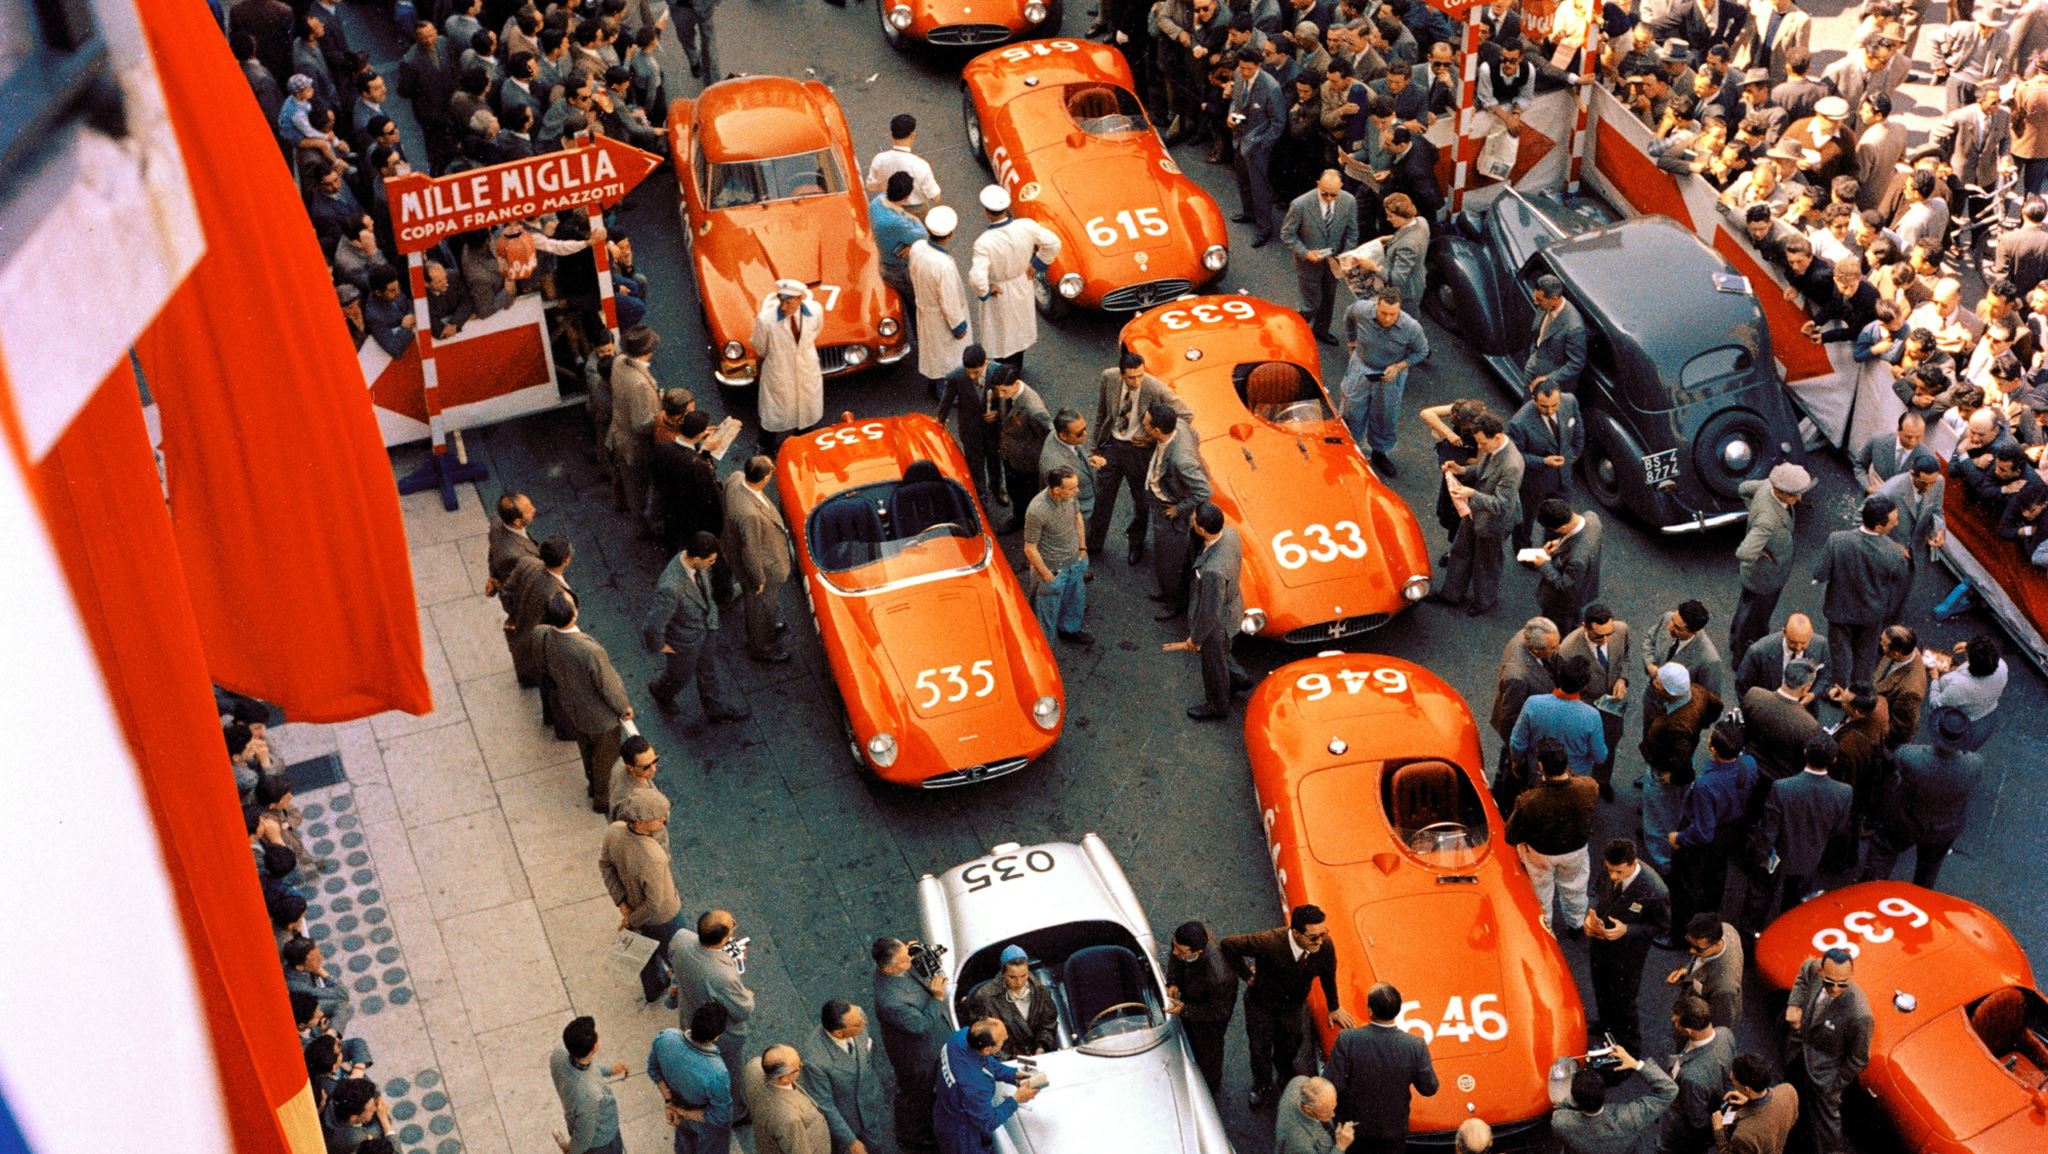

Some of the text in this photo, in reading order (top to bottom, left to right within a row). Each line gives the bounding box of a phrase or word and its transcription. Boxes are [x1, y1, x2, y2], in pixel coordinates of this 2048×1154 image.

[1001, 40, 1080, 63] 615
[401, 149, 617, 224] MILLE MIGLIA
[400, 182, 625, 241] COPPA FRANCO MAZZOTTI
[1085, 206, 1169, 247] 615
[1159, 300, 1256, 330] 633
[814, 422, 885, 451] 535
[1646, 462, 1679, 483] 8774
[1271, 520, 1368, 570] 633
[915, 659, 995, 709] 535
[1296, 668, 1408, 701] 646
[961, 850, 1056, 893] 035
[1811, 897, 1929, 959] 638
[1394, 992, 1509, 1045] 646
